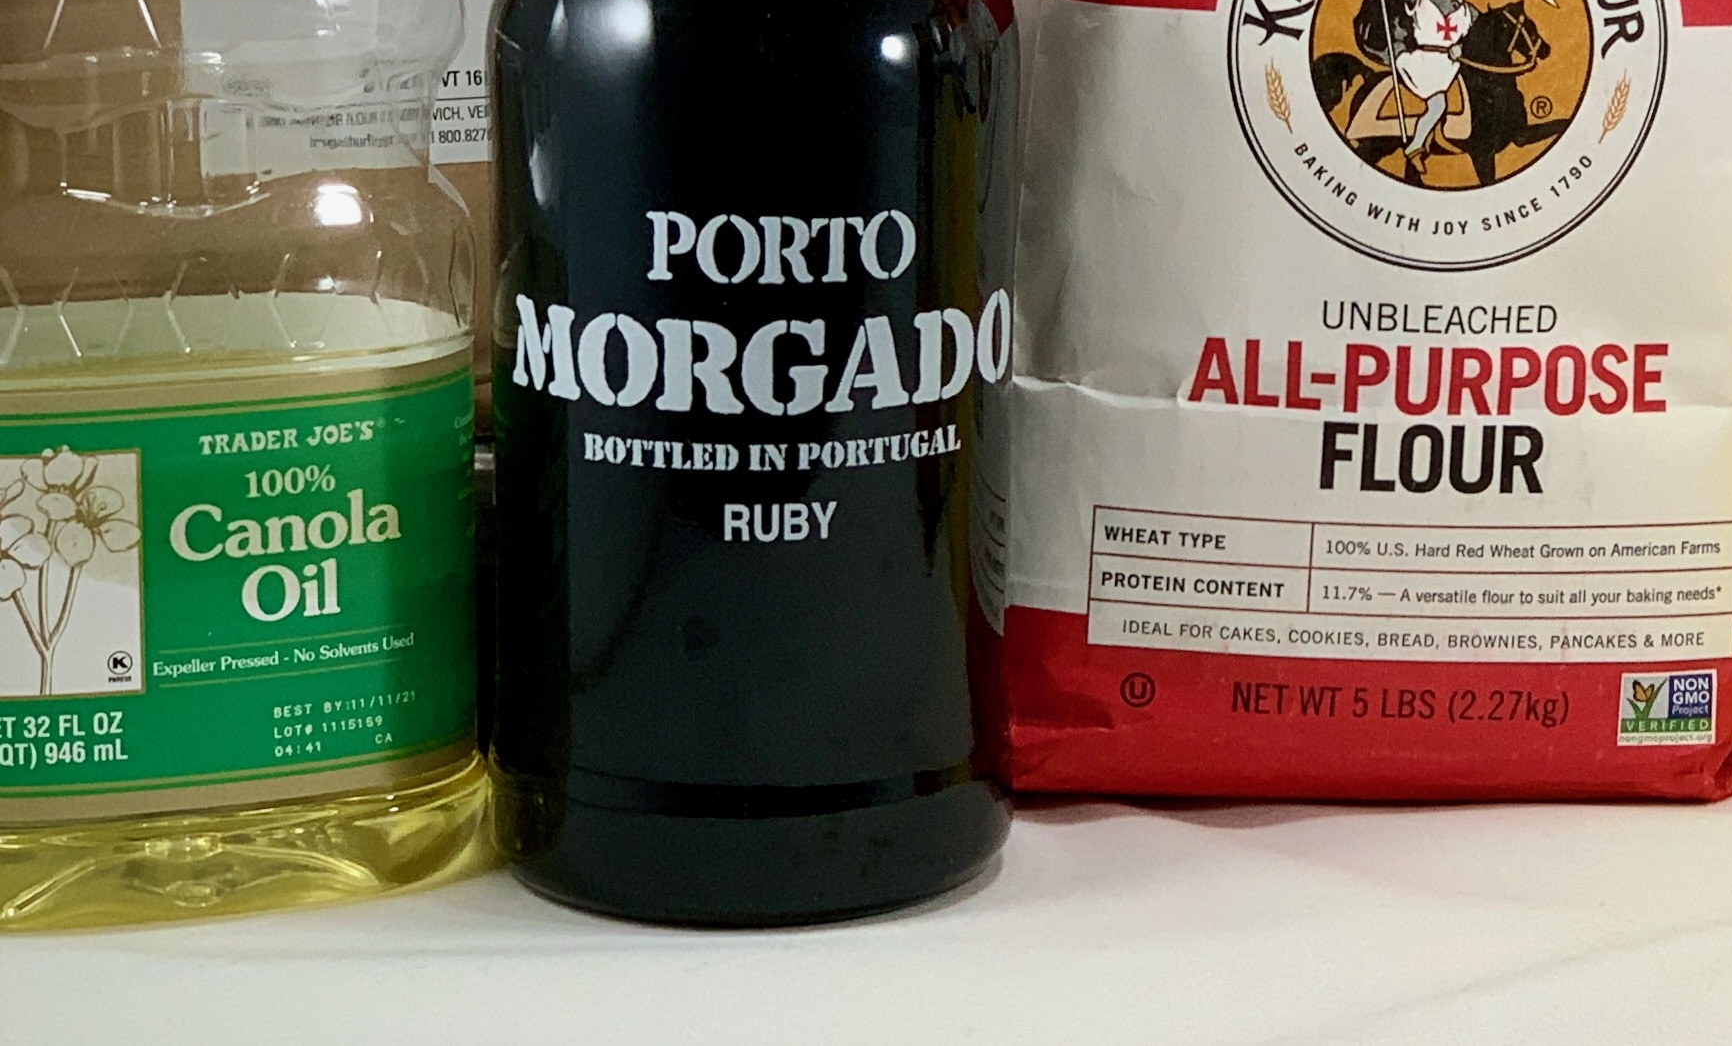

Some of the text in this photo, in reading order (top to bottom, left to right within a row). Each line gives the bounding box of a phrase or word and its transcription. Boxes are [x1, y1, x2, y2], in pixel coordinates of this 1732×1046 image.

[1294, 142, 1594, 235] BAKING WITH JOY SINCE 1790
[646, 209, 916, 284] PORTO
[1321, 300, 1558, 335] UNBLEACHED
[513, 287, 1012, 416] MORGADO
[1188, 336, 1669, 417] ALL-PURPOSE
[200, 427, 299, 455] TRADER
[584, 424, 961, 471] BOTTLED IN PORTUGAL
[1319, 421, 1545, 495] FLOUR
[244, 465, 336, 499] 100%
[170, 488, 401, 562] Canola
[723, 501, 838, 542] RUBY
[1104, 524, 1227, 550] WHEAT TYPE
[241, 558, 341, 622] Oil
[1100, 571, 1286, 598] PROTEIN CONTENT
[152, 632, 414, 679] Expeller Pressed No Solvents Used
[1231, 680, 1569, 729] NET WT 5 LBS (2.27kg)
[1672, 690, 1710, 704] GMO
[1673, 677, 1710, 692] NON
[23, 711, 123, 738] 32 FL OZ
[1625, 719, 1709, 731] VERIFIED
[44, 739, 128, 764] 946 mL
